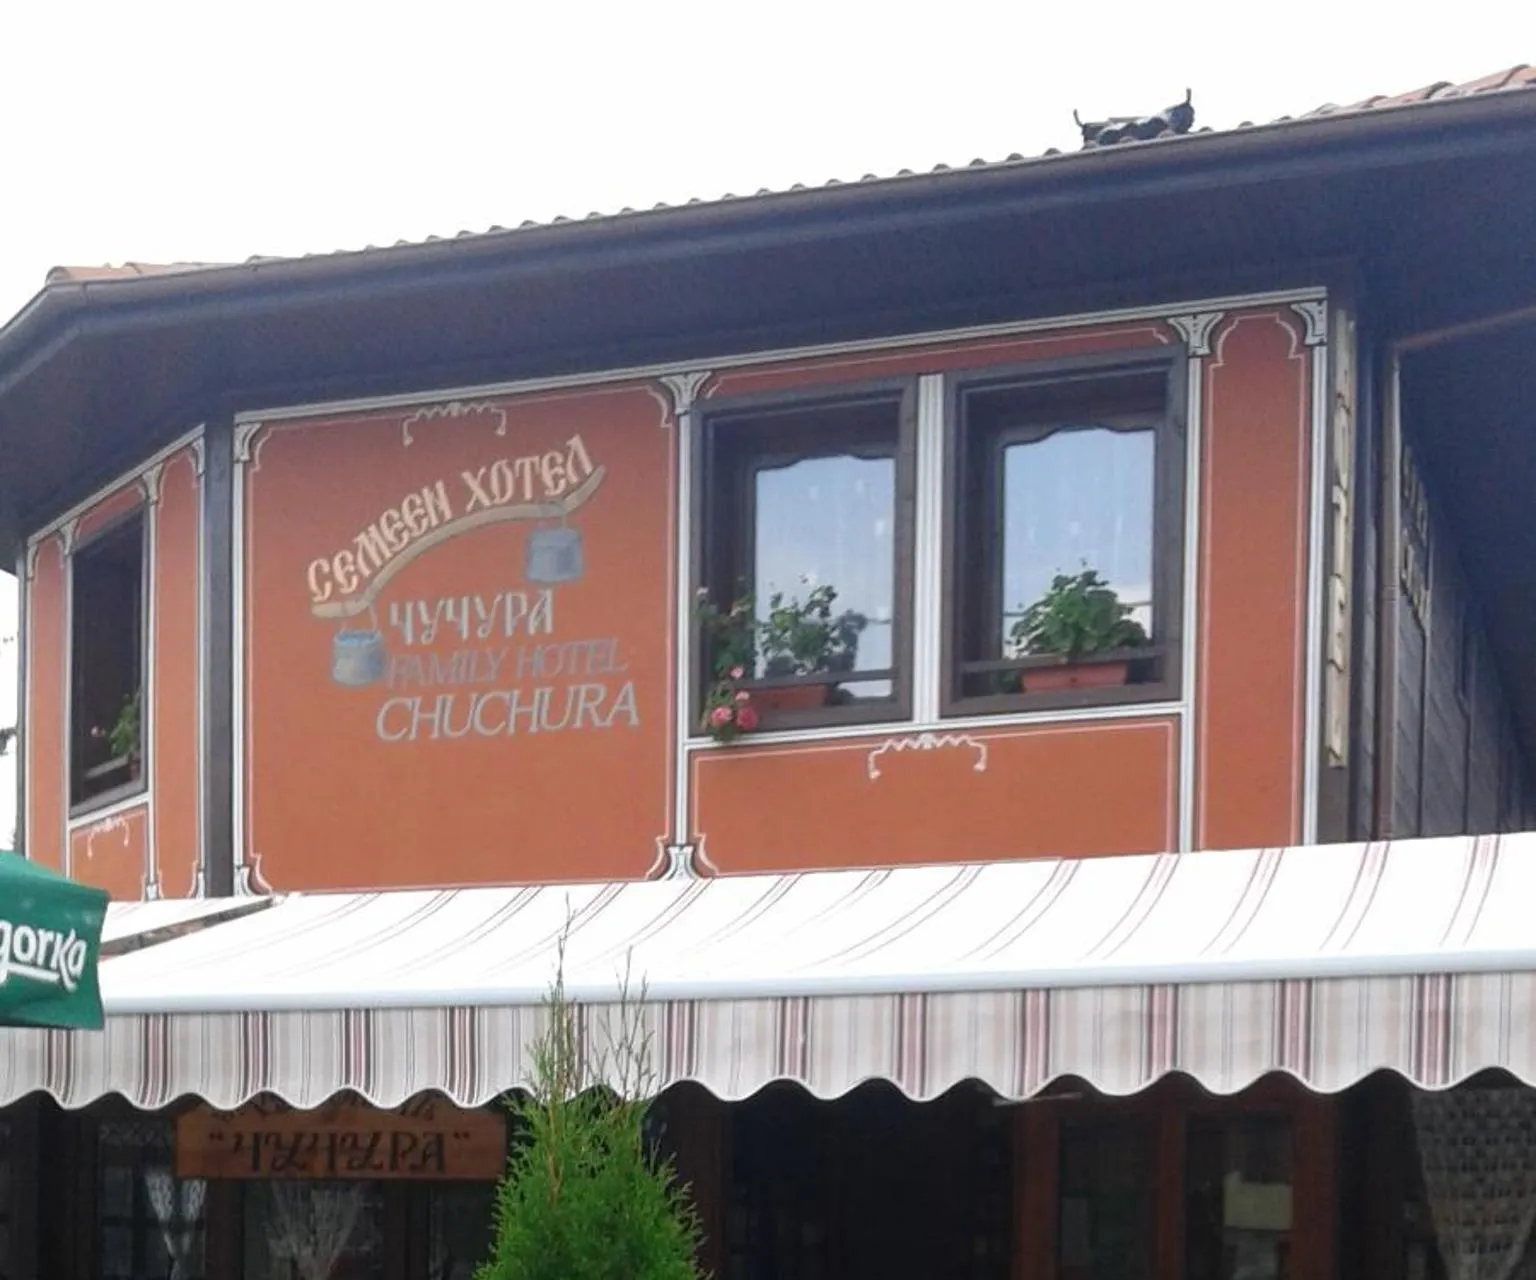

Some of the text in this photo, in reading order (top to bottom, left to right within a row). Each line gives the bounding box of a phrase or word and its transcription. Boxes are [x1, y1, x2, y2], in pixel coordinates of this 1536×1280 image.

[461, 433, 594, 512] ХОТЕЛ
[389, 588, 554, 646] ЧУЧУРА
[385, 637, 630, 688] FAMILY HOTEL
[376, 681, 640, 742] CHUCHURA
